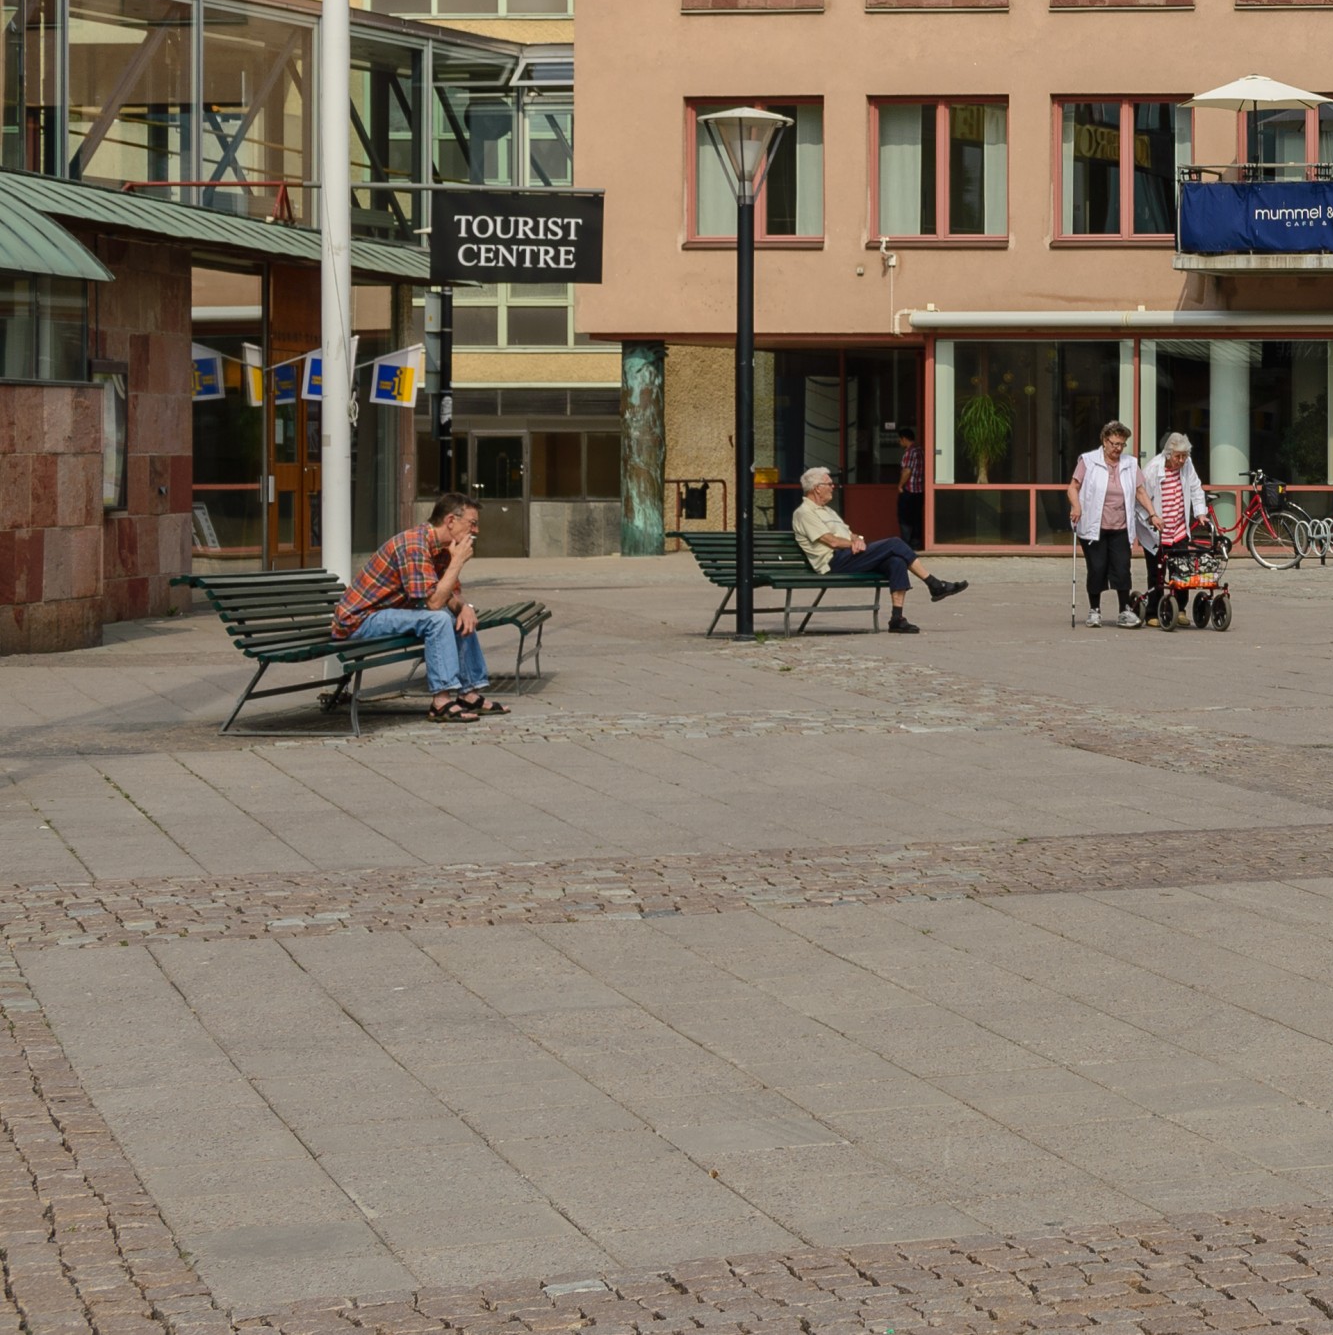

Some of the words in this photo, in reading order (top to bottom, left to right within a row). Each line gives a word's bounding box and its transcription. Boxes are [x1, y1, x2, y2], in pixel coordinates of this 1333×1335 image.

[1254, 204, 1322, 220] mummel
[454, 215, 583, 241] TOURIST
[457, 243, 577, 269] CENTRE
